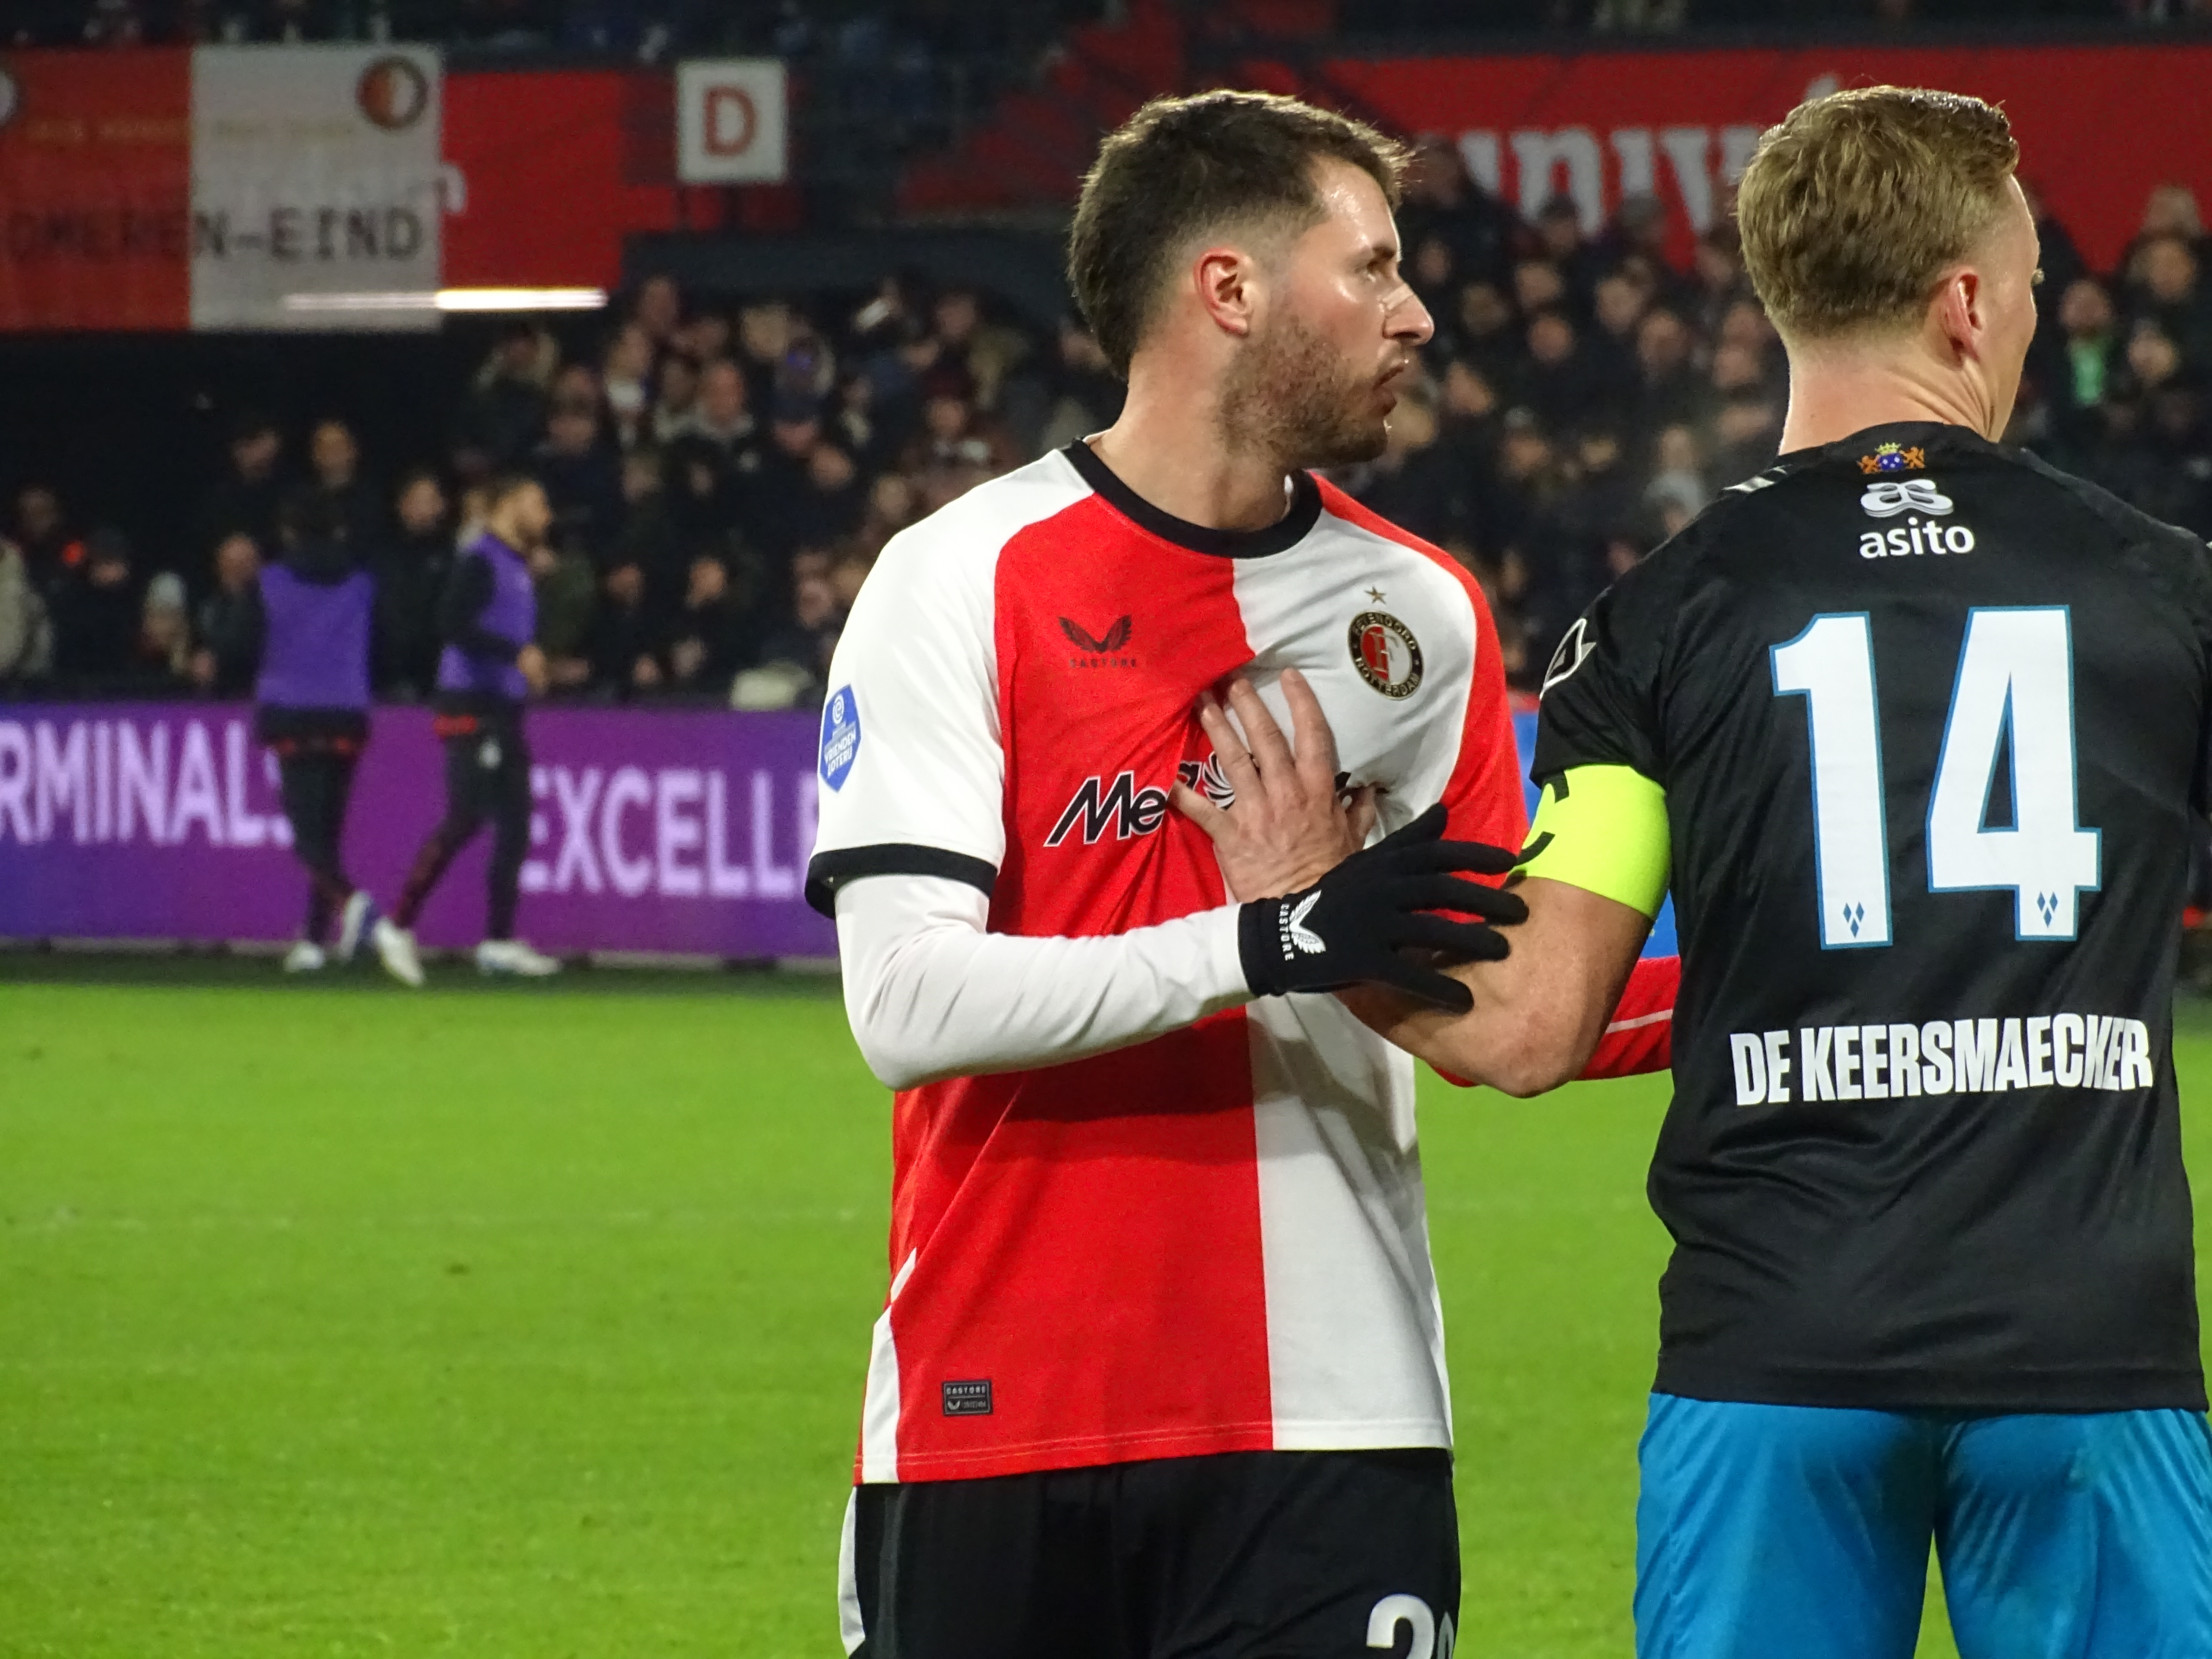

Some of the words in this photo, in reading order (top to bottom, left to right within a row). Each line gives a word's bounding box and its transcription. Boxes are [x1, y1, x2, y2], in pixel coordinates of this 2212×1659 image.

[705, 86, 757, 156] D
[1860, 517, 1975, 559] asito
[1769, 605, 2102, 951] 14
[1279, 903, 1295, 961] CASTORE
[1730, 1030, 1791, 1106] DE
[1801, 1013, 2153, 1102] KEERSMAECKER
